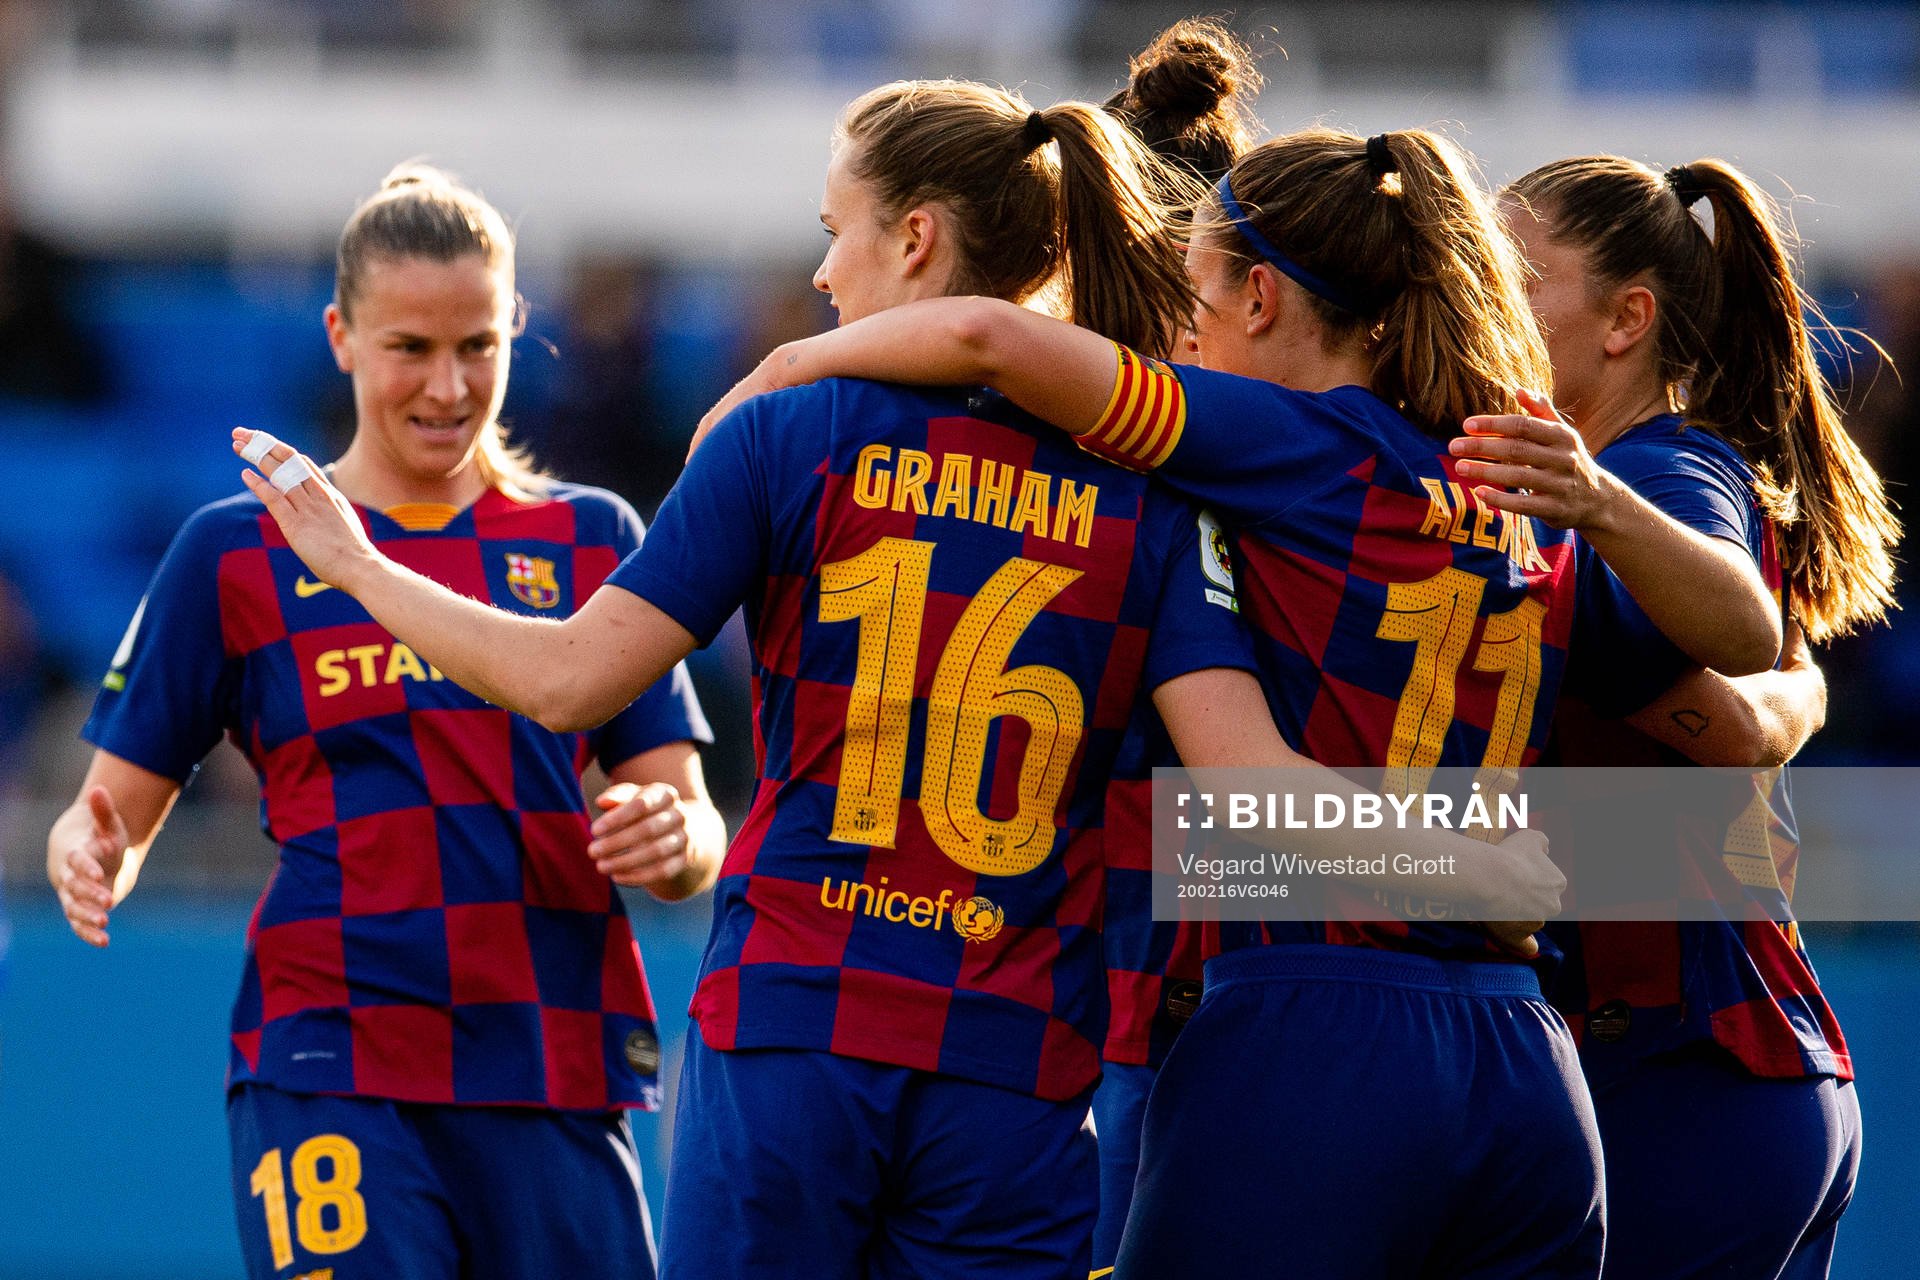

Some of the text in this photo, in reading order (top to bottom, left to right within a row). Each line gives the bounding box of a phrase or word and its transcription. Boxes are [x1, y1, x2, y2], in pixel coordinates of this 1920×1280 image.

[853, 443, 1099, 549] GRAHAM
[314, 641, 446, 698] STA
[818, 536, 1086, 877] 16
[1375, 565, 1550, 846] 11
[820, 876, 953, 932] unicef
[250, 1135, 369, 1272] 18
